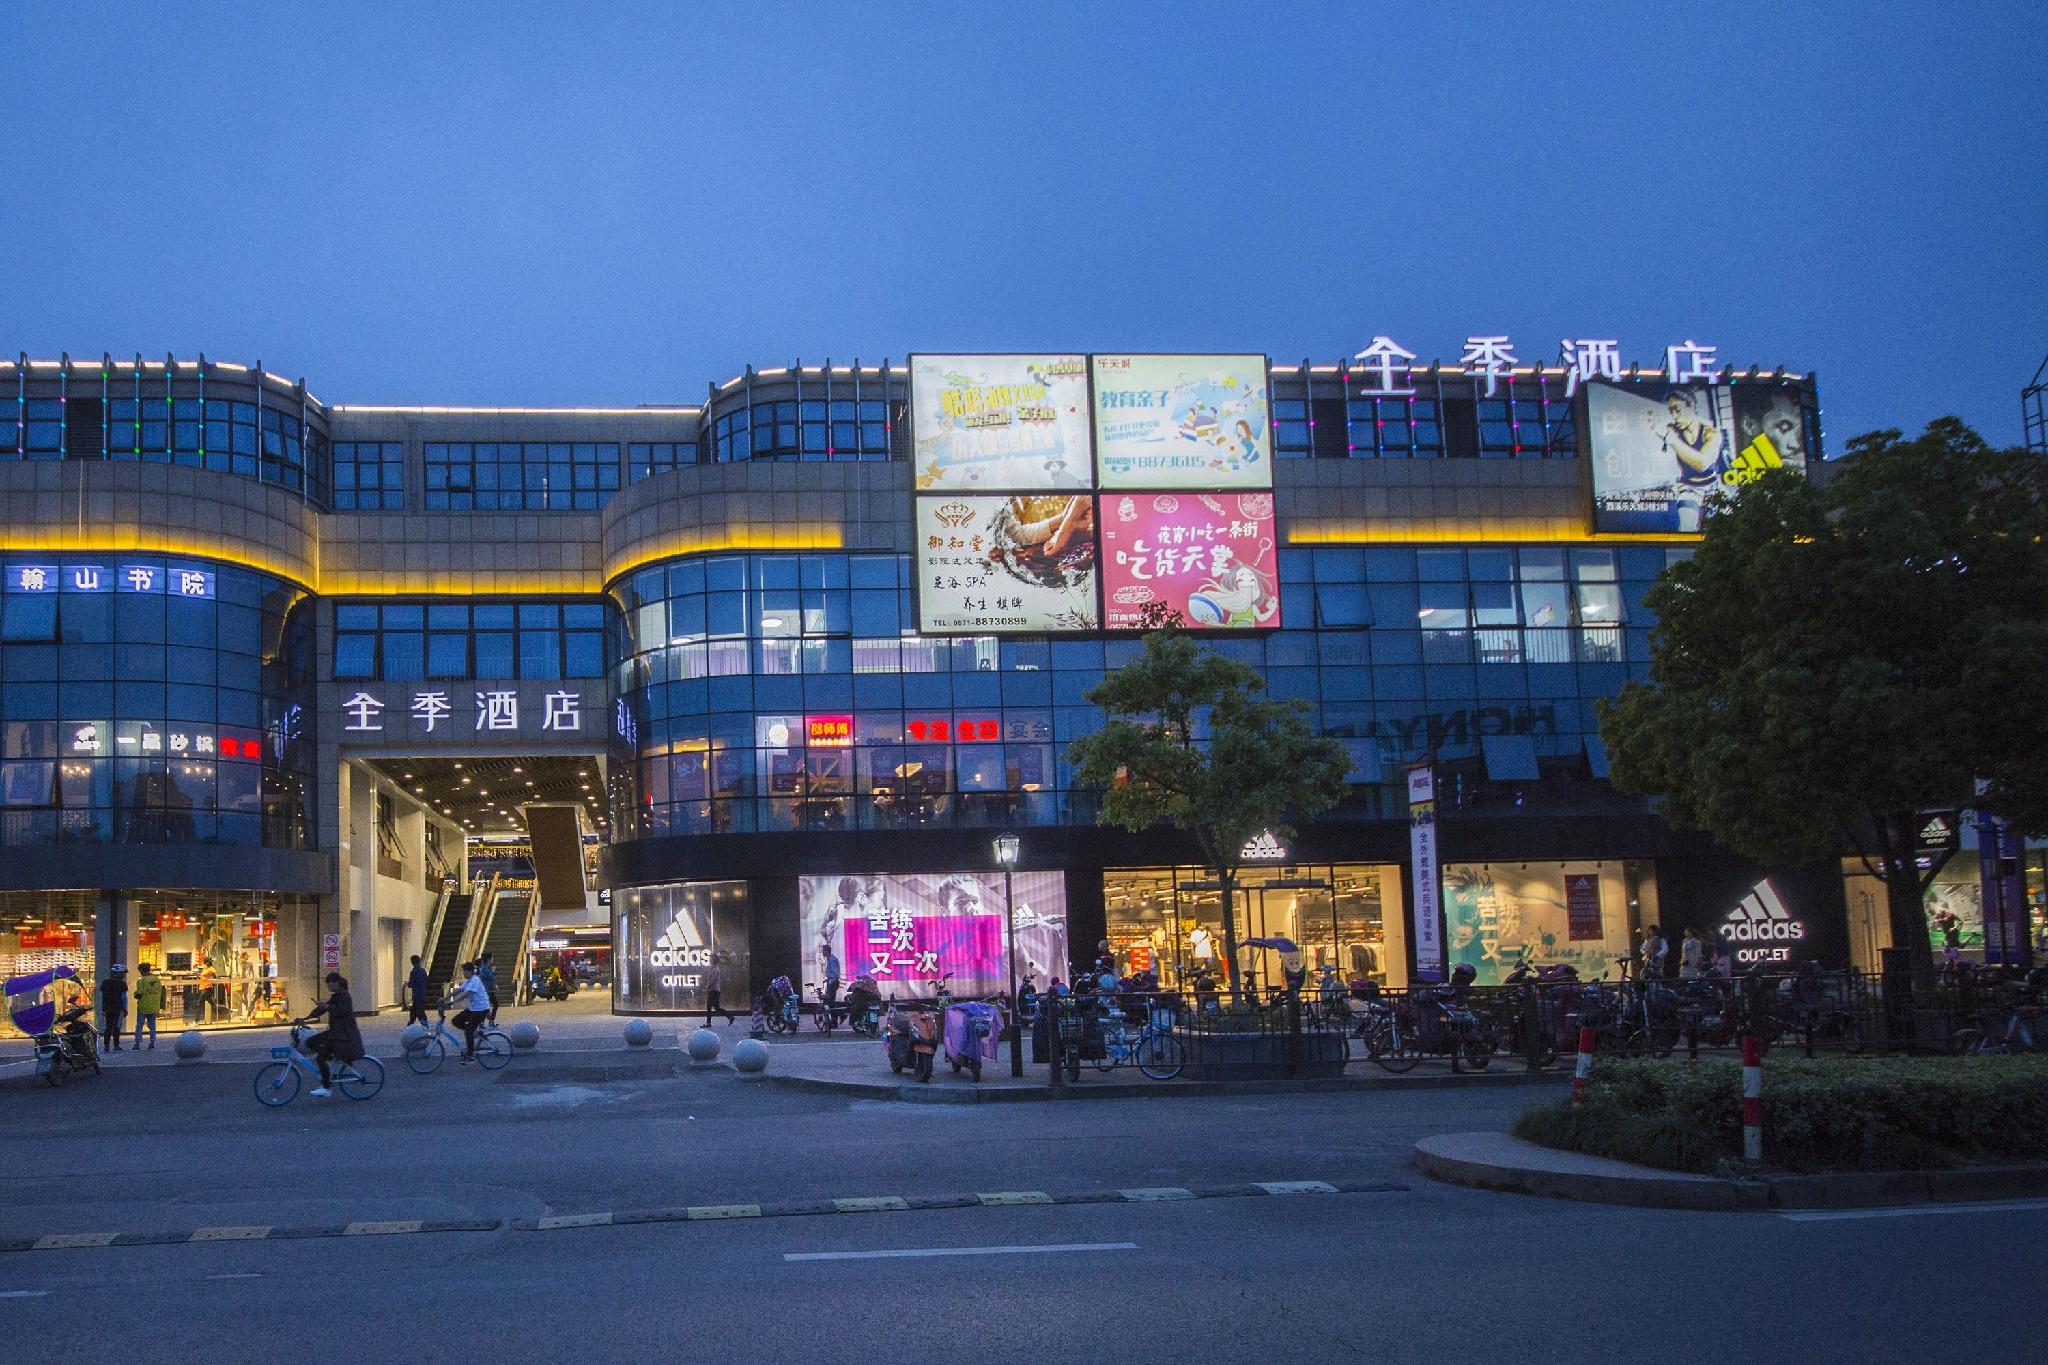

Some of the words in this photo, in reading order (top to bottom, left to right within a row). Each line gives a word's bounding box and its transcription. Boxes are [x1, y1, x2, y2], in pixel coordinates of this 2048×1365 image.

[1158, 520, 1258, 544] 夜宵小吃一条街
[1116, 540, 1234, 580] 吃货天堂
[965, 576, 987, 588] SPA
[342, 690, 581, 733] 全季酒店
[1920, 830, 1951, 839] adidas
[1477, 895, 1520, 918] 苦练
[868, 907, 914, 930] 苦练
[1720, 918, 1805, 941] adidas
[868, 930, 915, 952] 一次
[650, 946, 712, 967] adidas
[869, 951, 938, 974] 又一次
[1737, 947, 1791, 962] OUTLET
[662, 975, 702, 987] OUTLET
